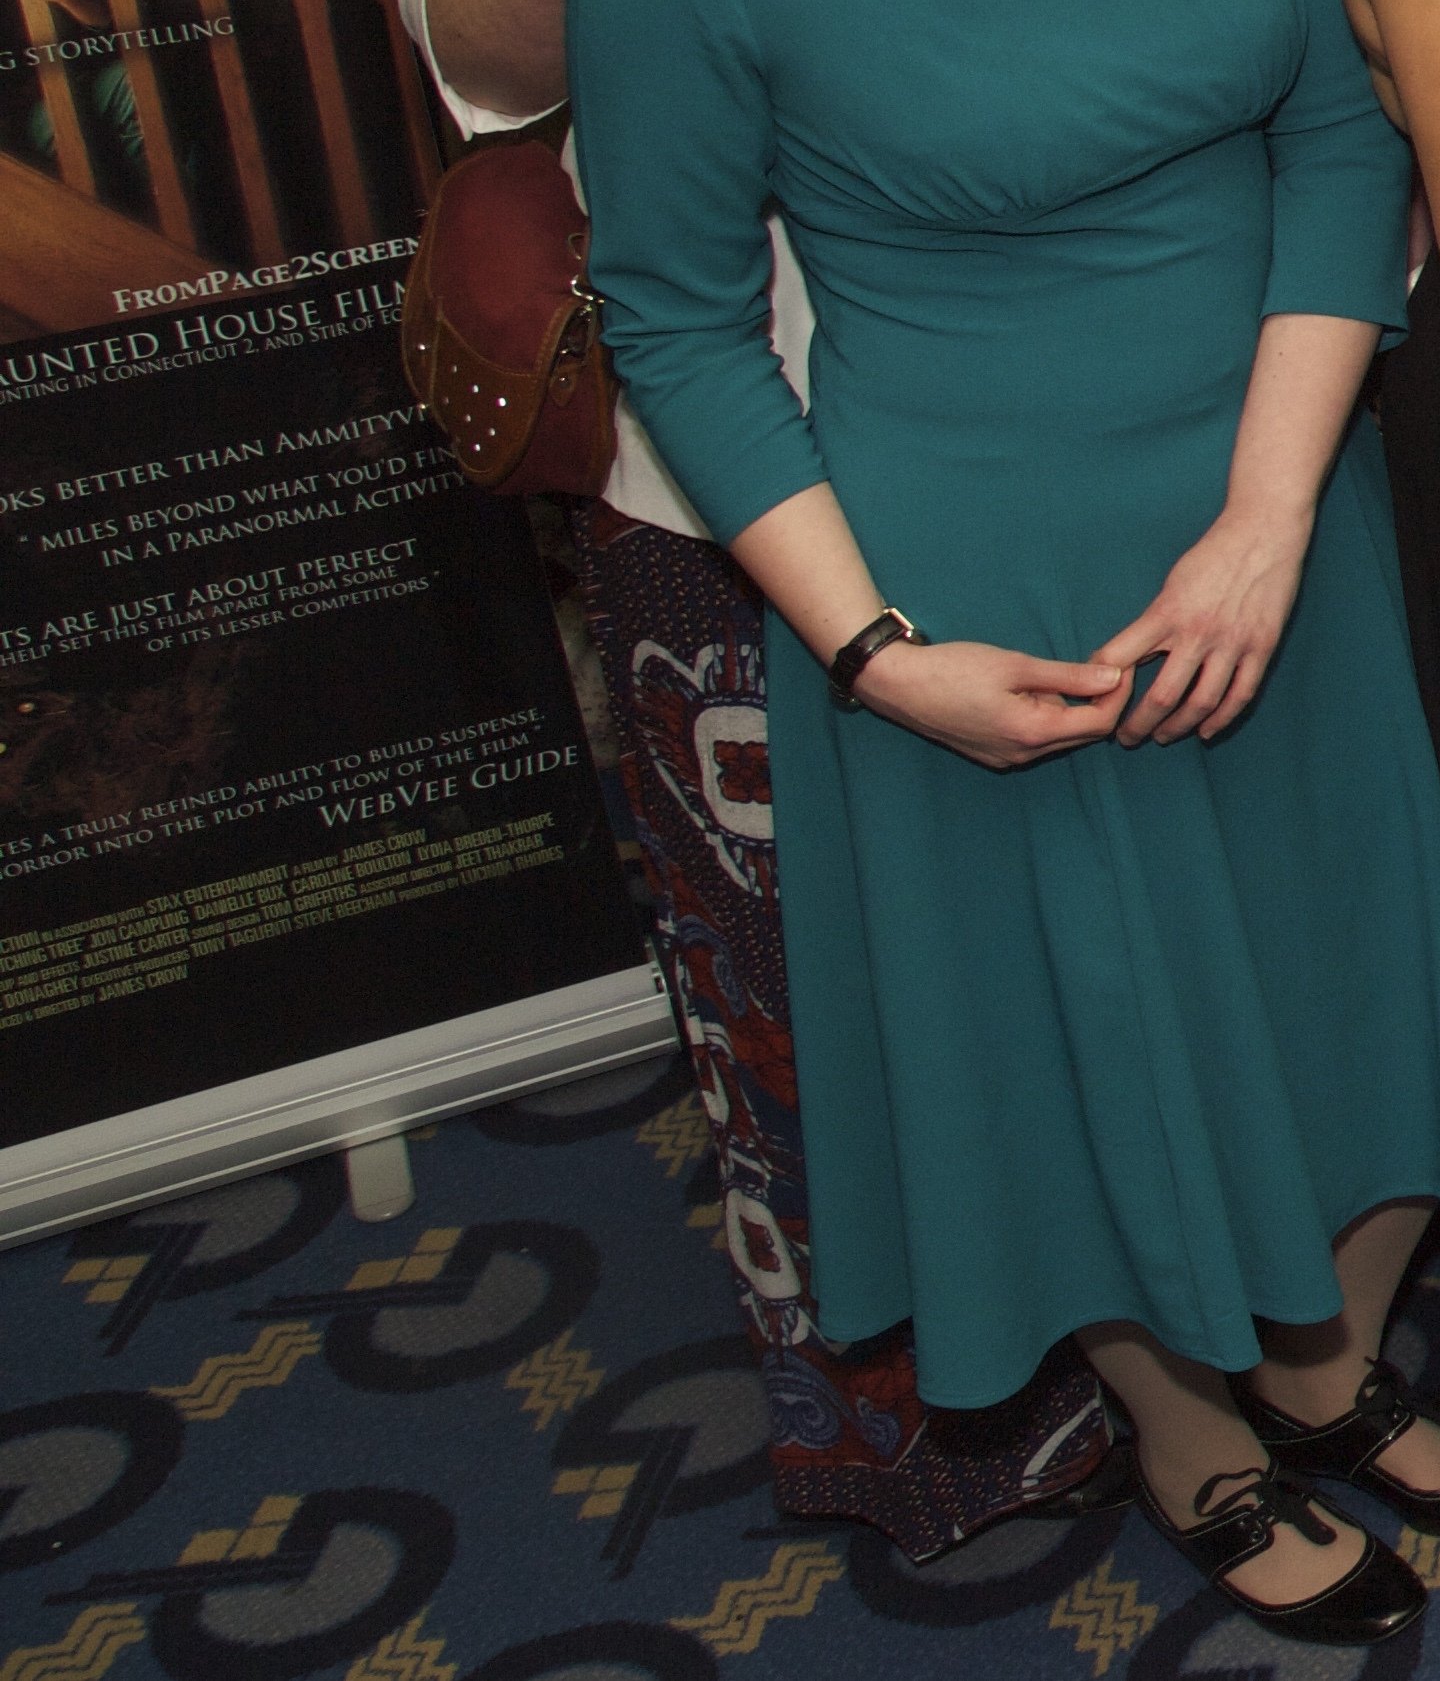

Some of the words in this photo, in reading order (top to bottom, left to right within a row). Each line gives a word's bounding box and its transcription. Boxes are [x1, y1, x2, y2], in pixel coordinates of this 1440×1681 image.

[23, 16, 235, 67] STORYTELLING
[73, 371, 98, 390] IN
[102, 339, 238, 383] CONNECTICUT
[263, 331, 305, 353] AND
[308, 319, 349, 344] STIR
[350, 314, 376, 335] OF
[174, 299, 321, 352] HOUSE
[39, 517, 119, 553] MILES
[129, 493, 237, 534] BEYOND
[242, 475, 320, 509] WHAT
[327, 455, 408, 491] YOU'D
[56, 459, 171, 503] BETTER
[175, 439, 264, 477] THAN
[102, 545, 134, 568] IN
[142, 540, 161, 560] A
[166, 499, 347, 554] PARANORMAL
[0, 644, 51, 668] HELP
[58, 633, 94, 653] SET
[101, 621, 150, 645] THIS
[157, 606, 205, 631] FILM
[210, 591, 270, 620] APART
[277, 577, 337, 604] FROM
[342, 564, 398, 590] SOME
[42, 611, 99, 642] ARE
[109, 591, 176, 629] JUST
[186, 567, 286, 608] ABOUT
[299, 538, 418, 582] PERFECT
[147, 634, 175, 653] OF
[179, 625, 212, 646] ITS
[218, 609, 286, 638] LESSER
[291, 575, 430, 620] COMPETITORS
[40, 833, 55, 847] A
[60, 809, 134, 841] TRULY
[139, 785, 238, 822] REFINED
[242, 762, 326, 796] ABILITY
[330, 754, 361, 771] TO
[367, 736, 434, 764] BUILD
[95, 828, 154, 856] INTO
[160, 814, 206, 837] THE
[212, 798, 268, 825] PLOT
[274, 784, 324, 809] AND
[330, 767, 390, 795] FLOW
[396, 759, 425, 777] OF
[431, 746, 476, 768] THE
[479, 732, 530, 758] FILM
[470, 744, 579, 791] GUIDE
